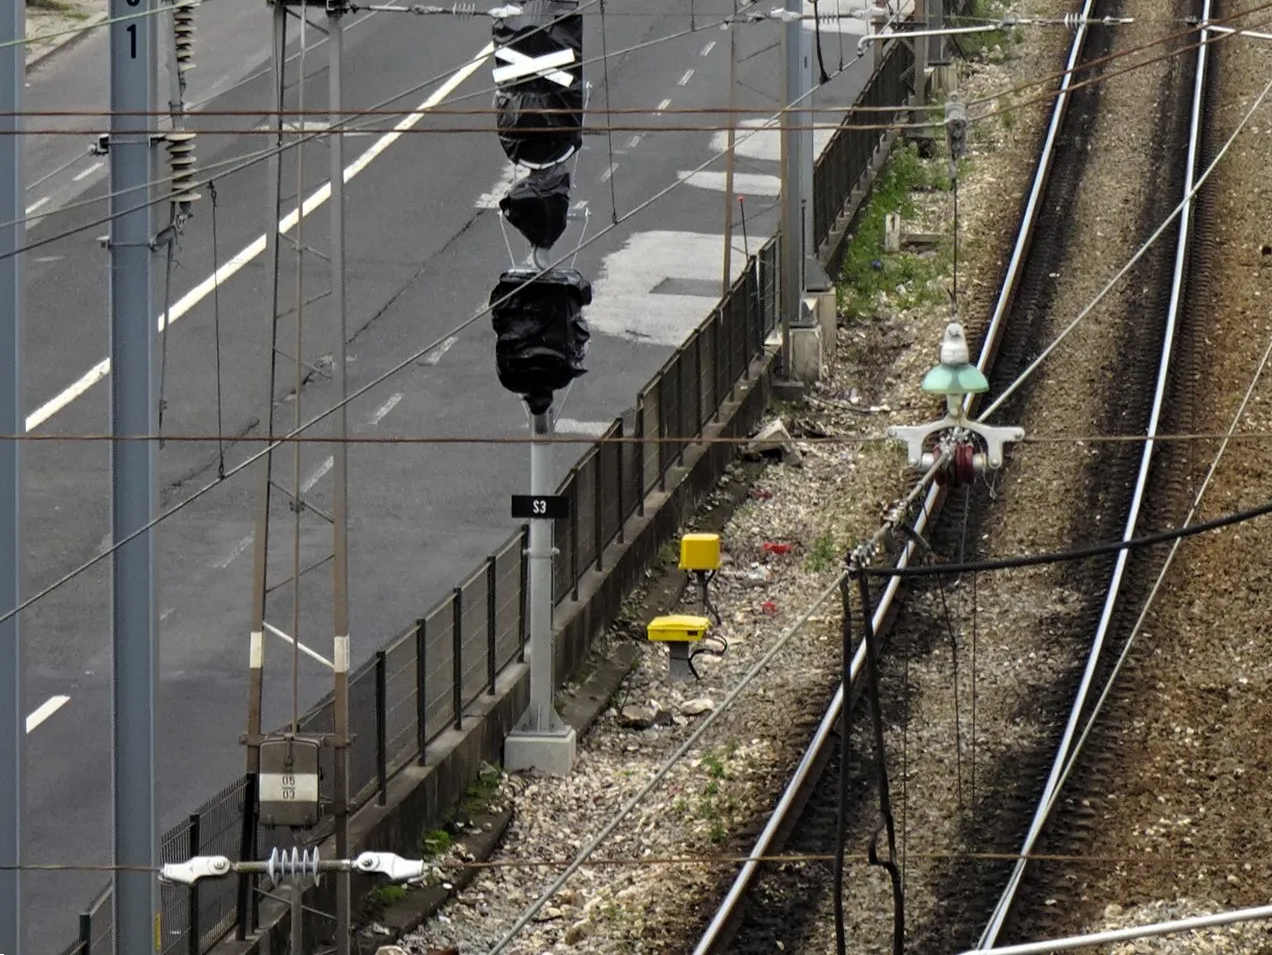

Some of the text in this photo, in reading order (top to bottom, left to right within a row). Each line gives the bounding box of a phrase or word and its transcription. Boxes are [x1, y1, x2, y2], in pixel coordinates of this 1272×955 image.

[532, 499, 547, 514] S3
[282, 775, 295, 786] 05
[282, 790, 295, 799] 03
